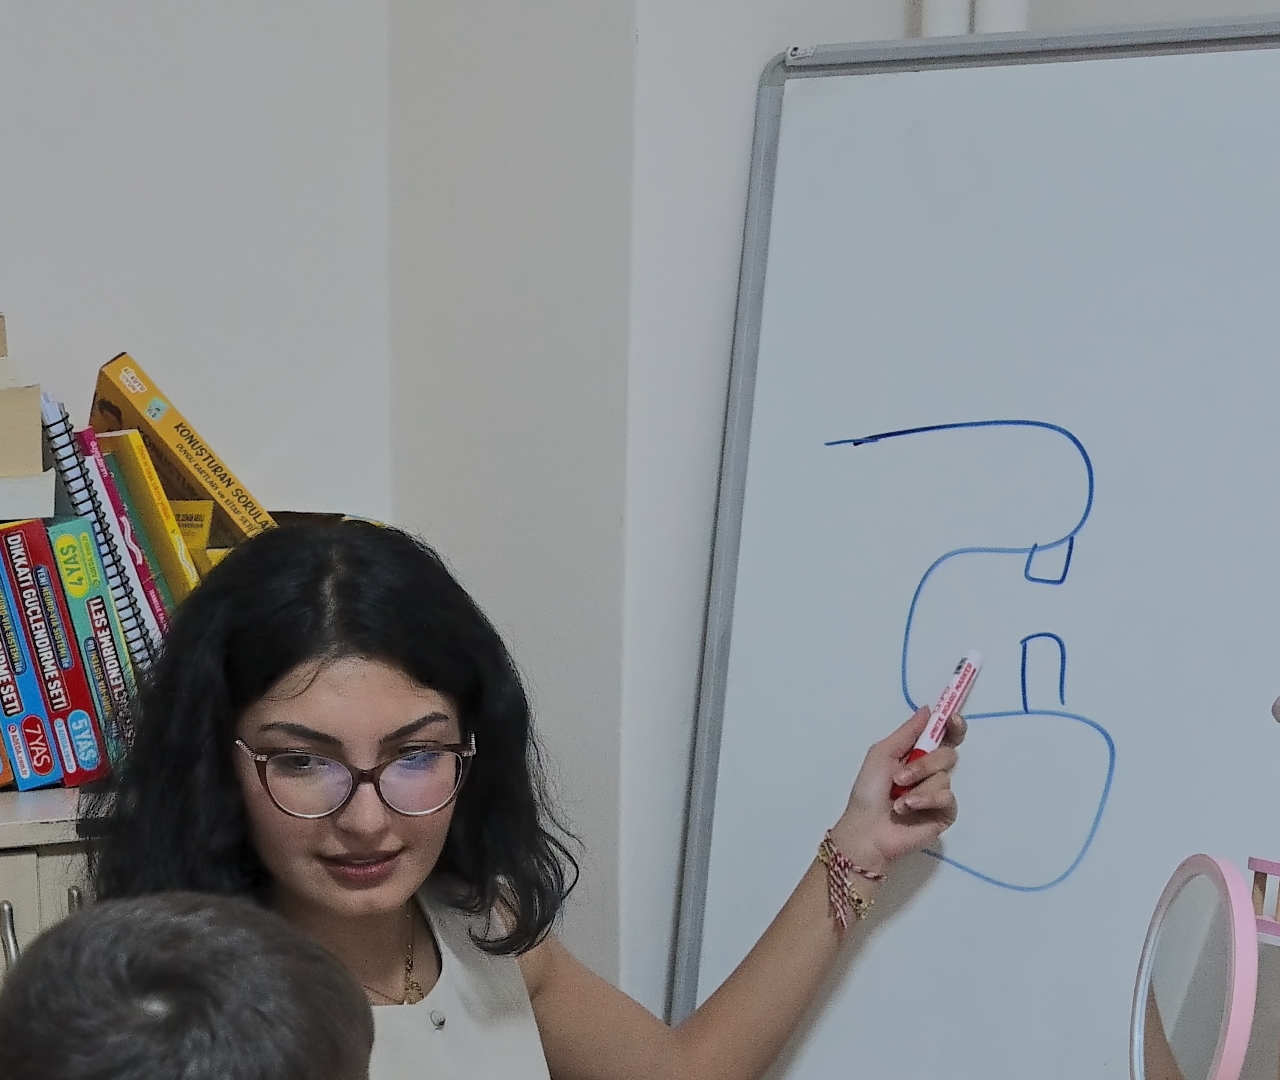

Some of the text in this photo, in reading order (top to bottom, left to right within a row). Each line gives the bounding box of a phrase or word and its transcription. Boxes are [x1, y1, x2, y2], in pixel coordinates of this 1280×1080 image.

[172, 419, 234, 490] KONUŞTURAN
[230, 485, 272, 532] SORULA
[68, 576, 84, 588] 4
[23, 724, 41, 736] 7
[70, 718, 88, 731] 5
